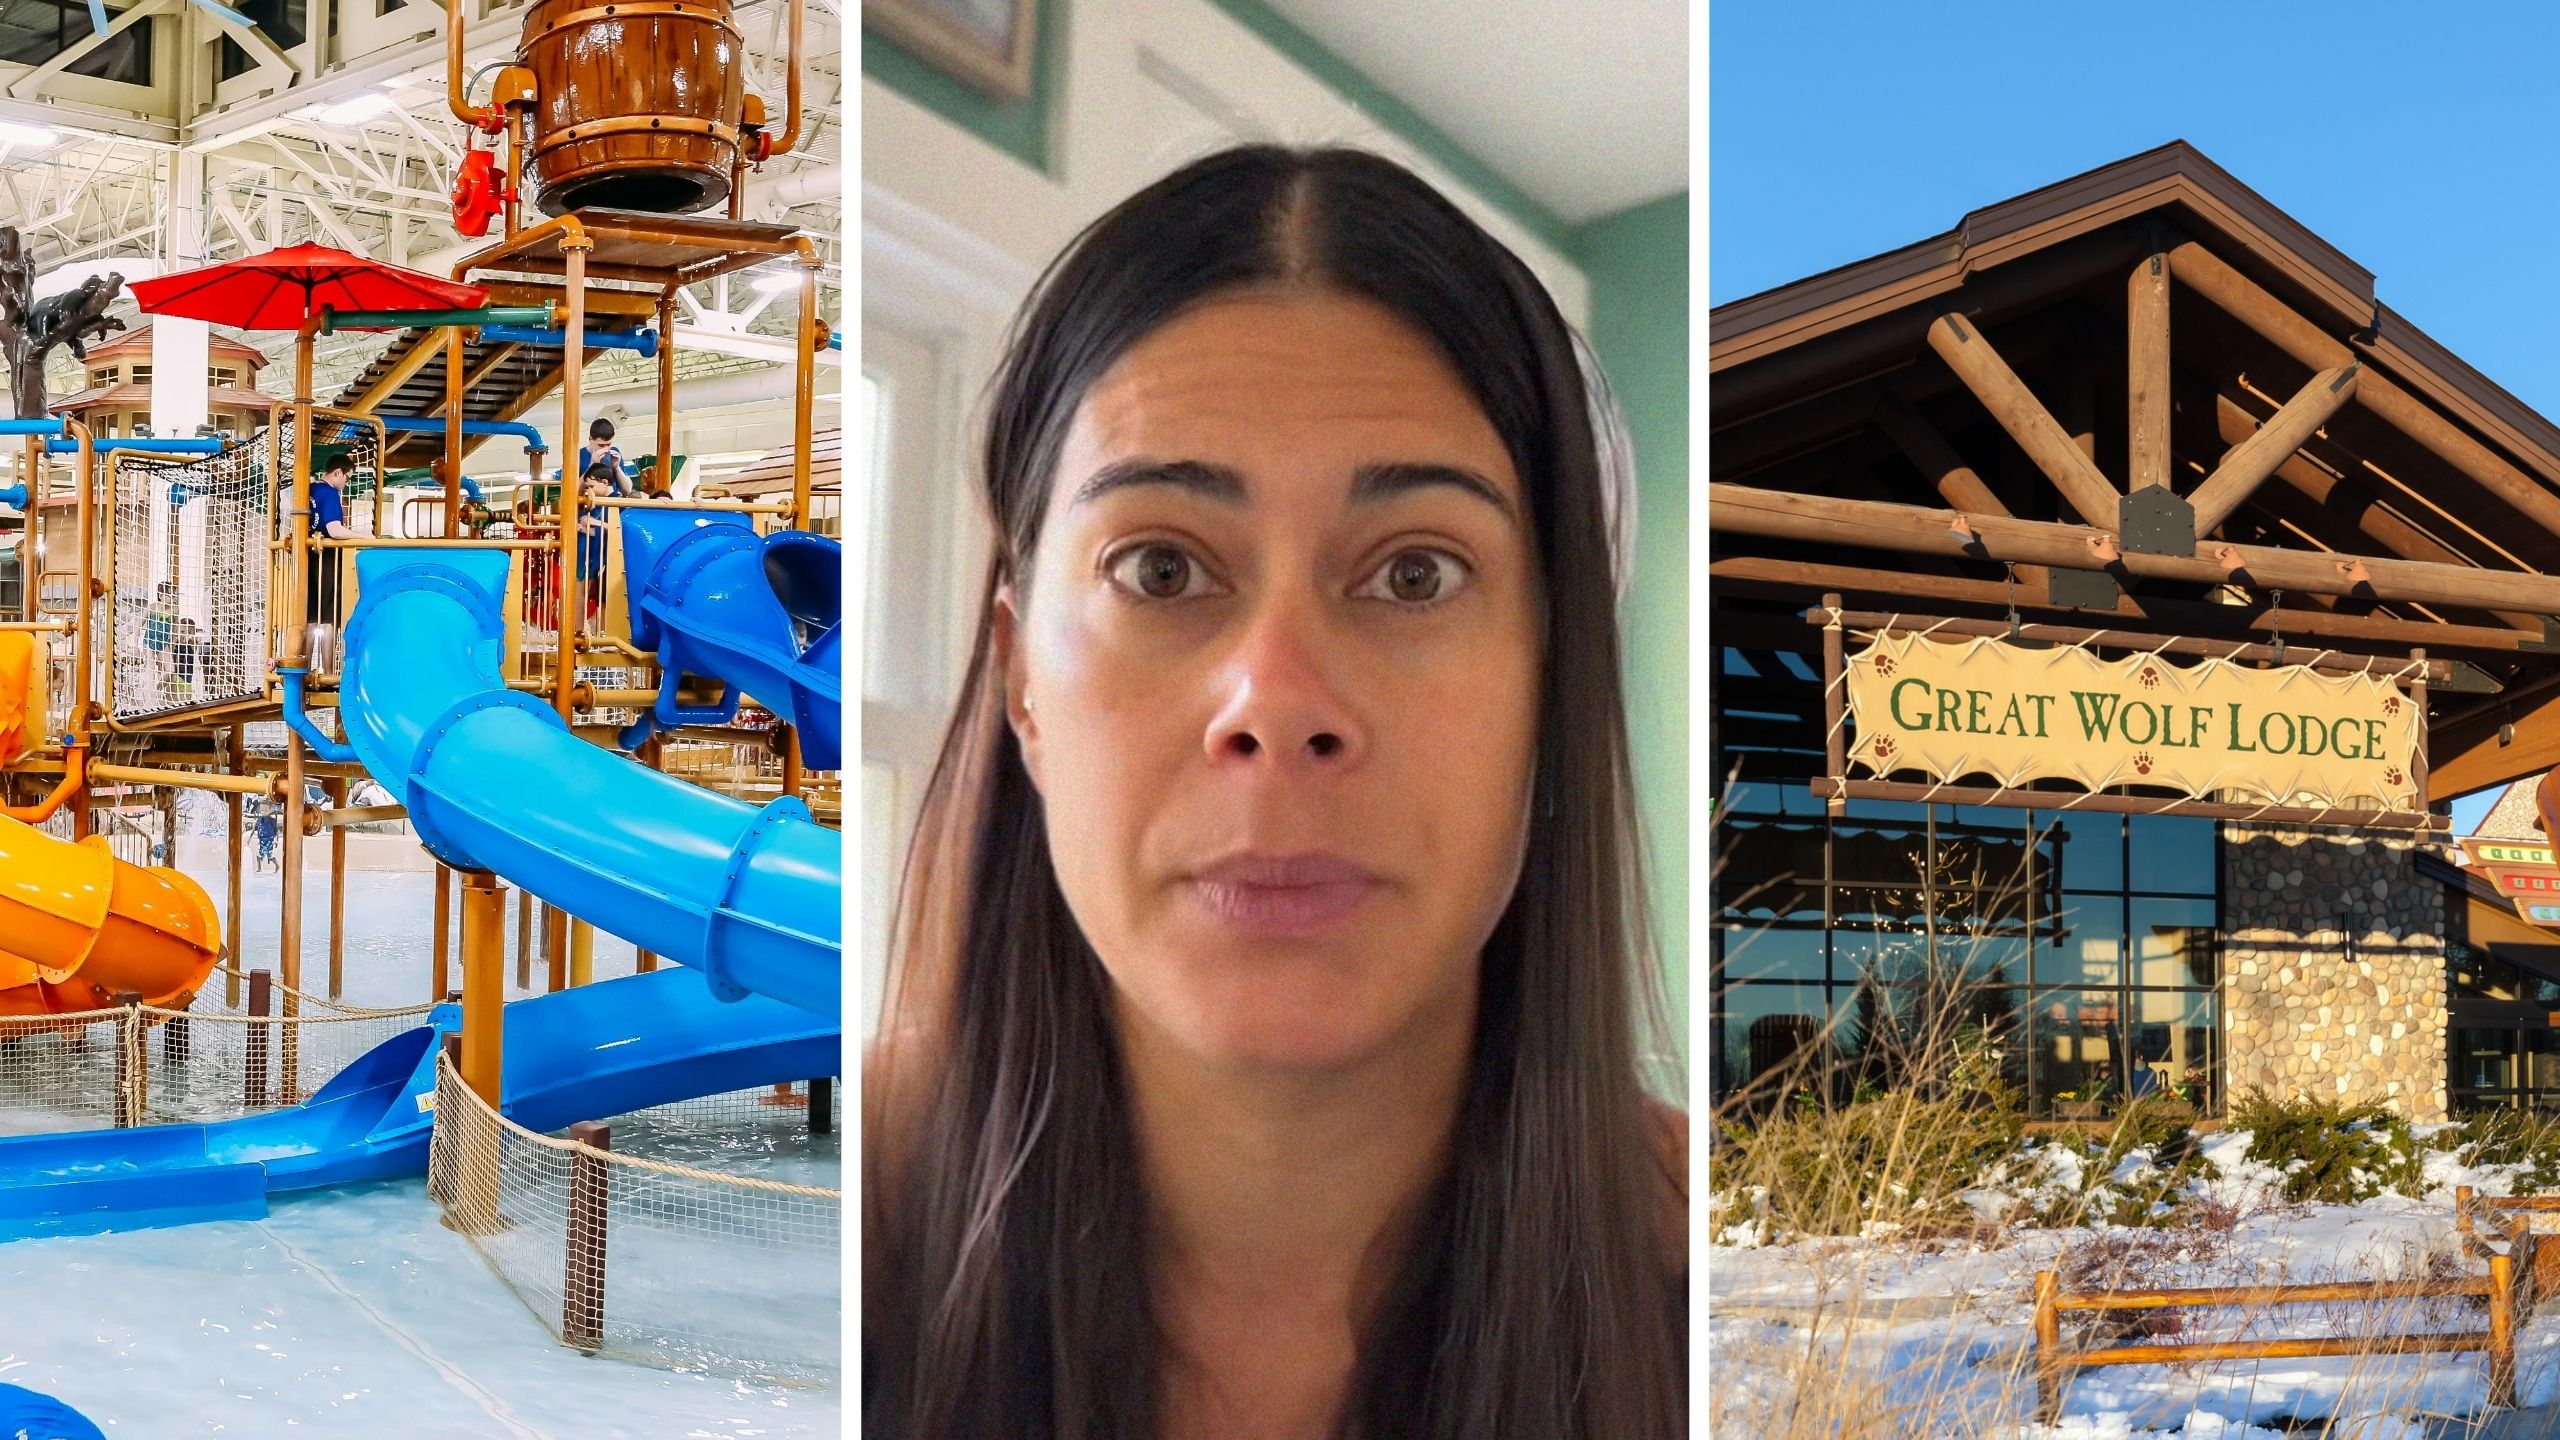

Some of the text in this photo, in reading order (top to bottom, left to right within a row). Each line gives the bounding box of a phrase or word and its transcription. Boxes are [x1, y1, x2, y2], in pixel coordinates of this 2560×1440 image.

[1890, 677, 2388, 761] GREAT WOLF LODGE
